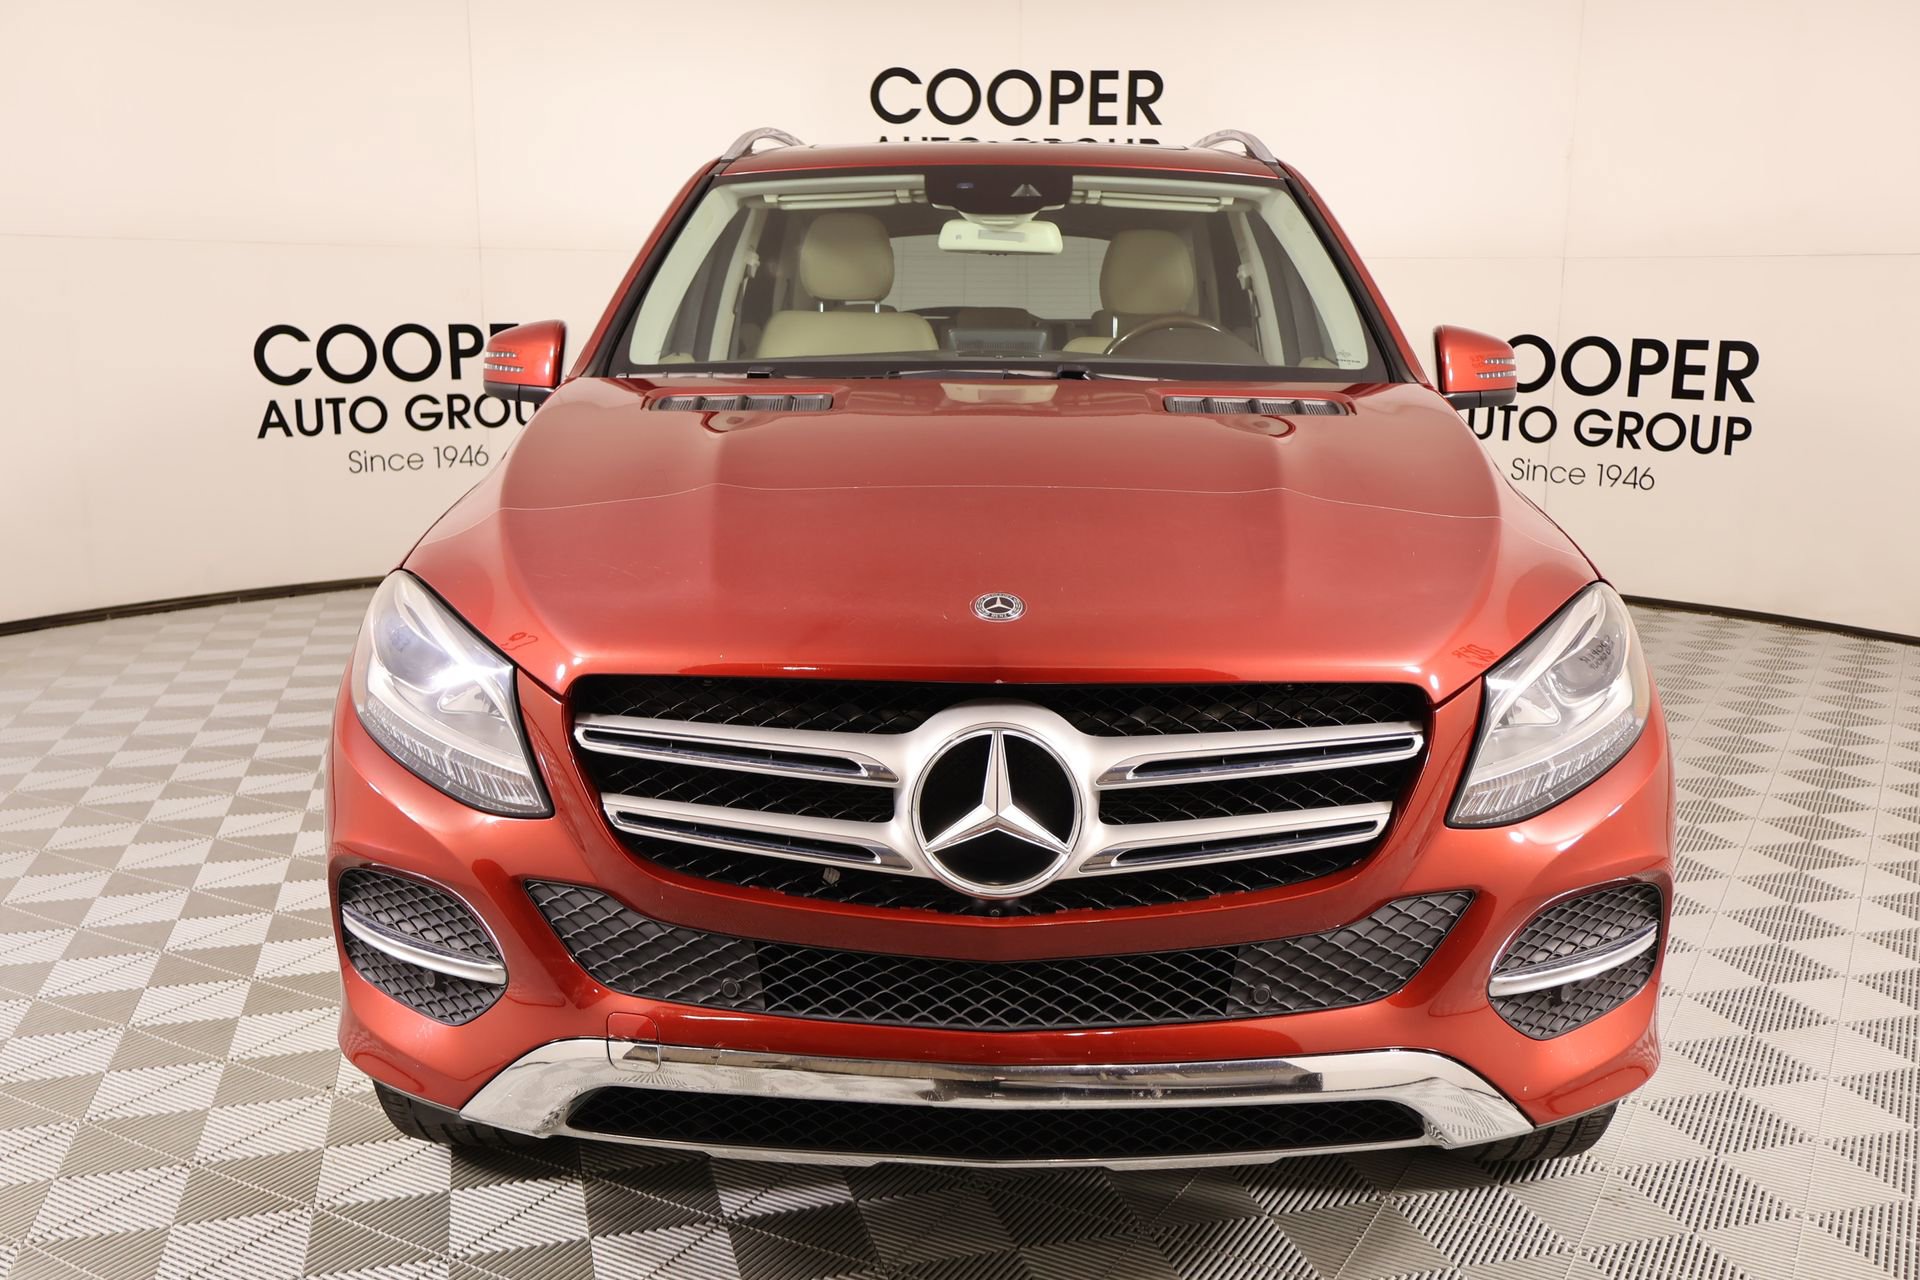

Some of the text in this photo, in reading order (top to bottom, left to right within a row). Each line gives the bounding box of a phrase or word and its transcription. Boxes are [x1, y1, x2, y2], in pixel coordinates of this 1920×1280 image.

[870, 66, 1164, 126] COOPER
[253, 323, 519, 386] COOP
[1506, 333, 1760, 404] OOPER
[257, 393, 540, 439] AUTO GROU
[1468, 405, 1753, 456] UTO GROUP
[348, 444, 490, 474] Since 1946
[1510, 457, 1656, 491] Since 1946
